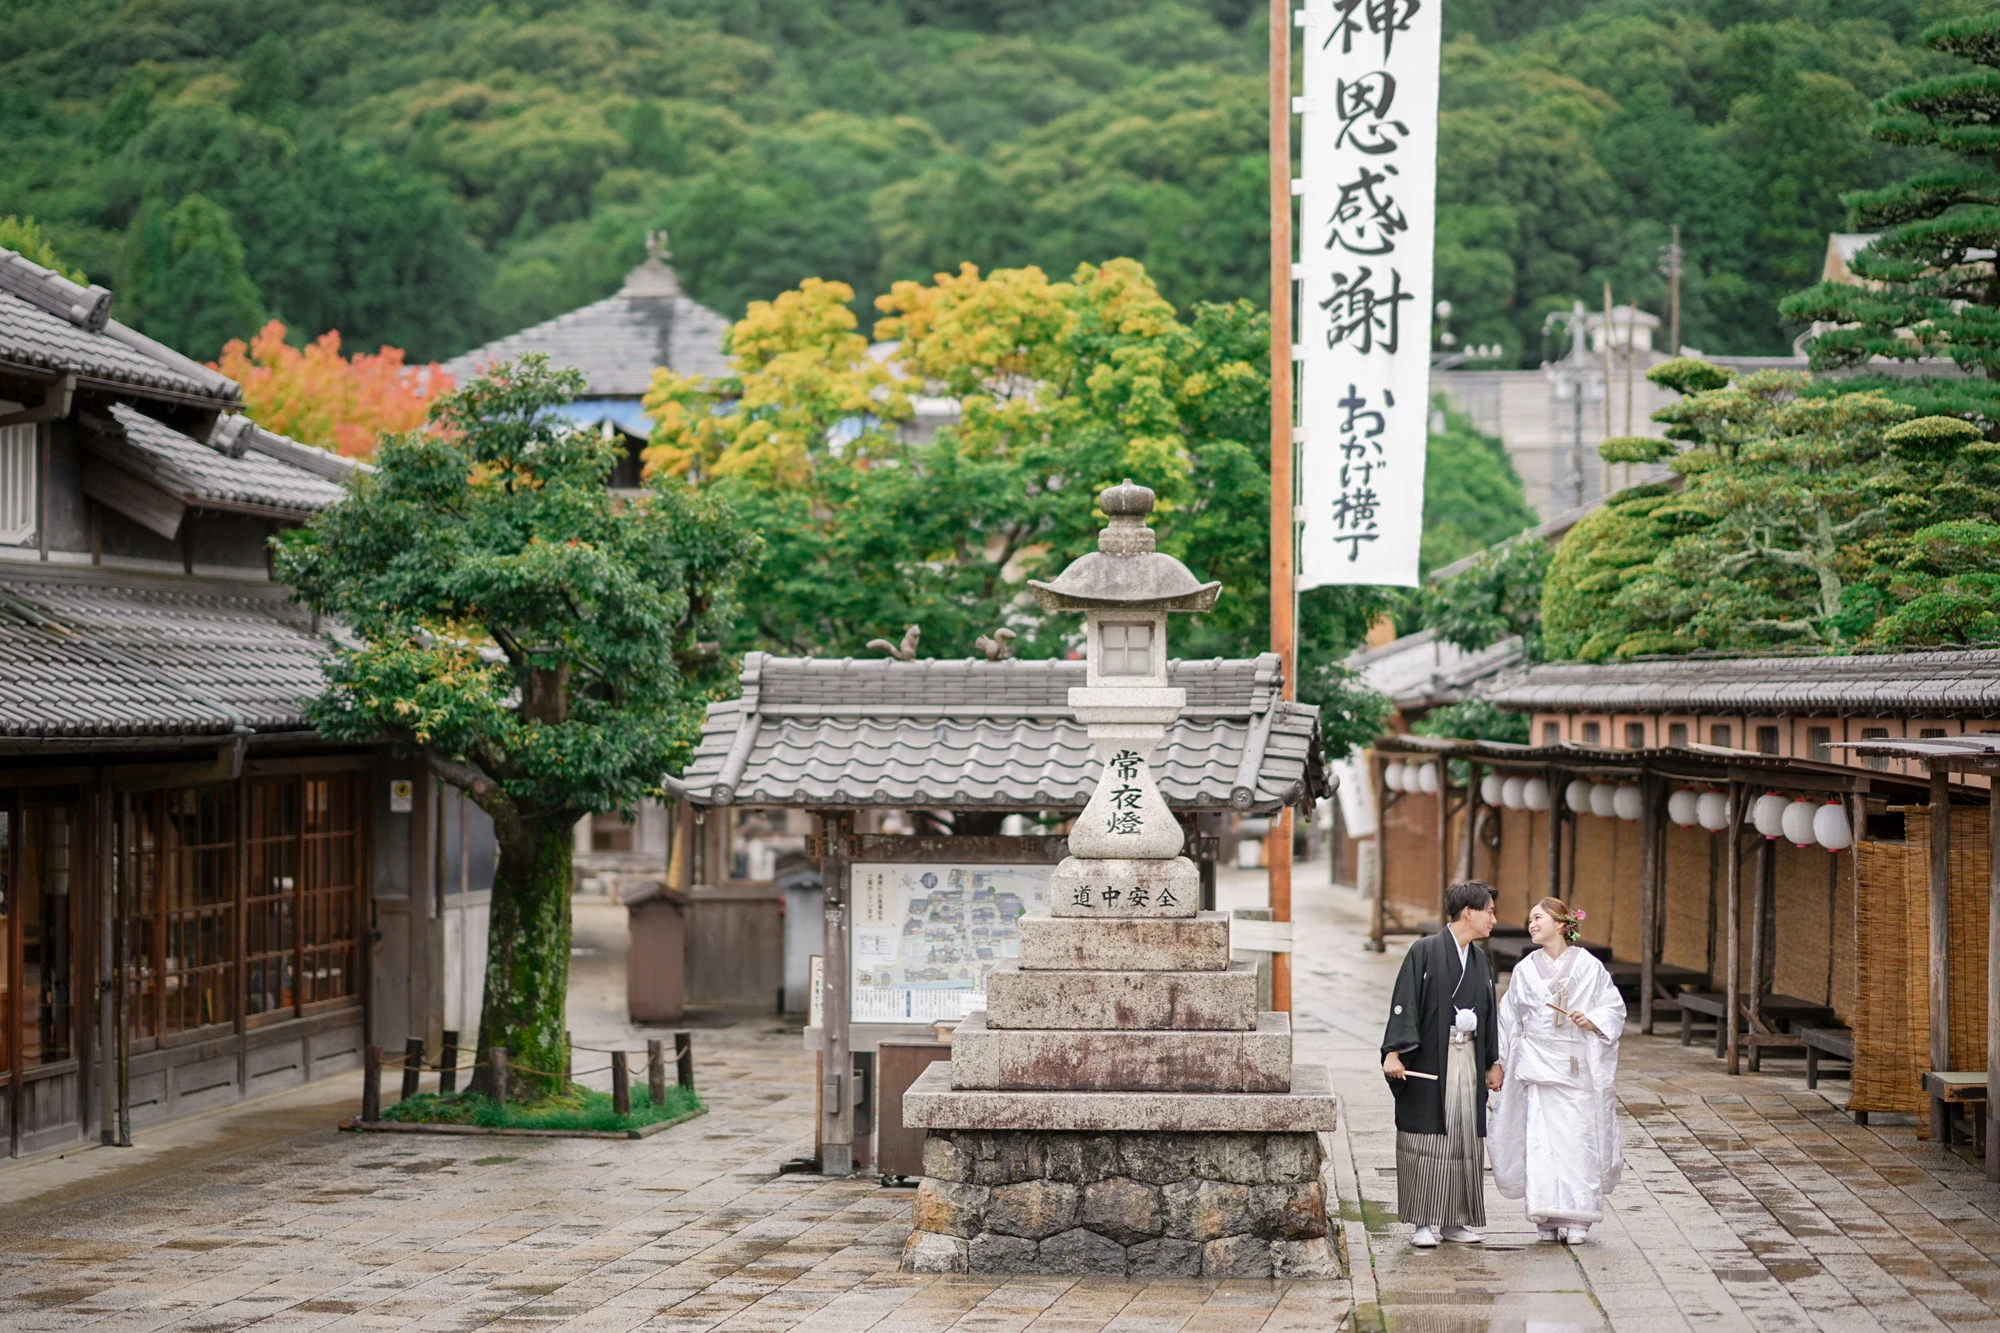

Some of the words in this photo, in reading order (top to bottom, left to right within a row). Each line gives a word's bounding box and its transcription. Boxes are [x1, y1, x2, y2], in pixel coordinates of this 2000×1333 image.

[1319, 0, 1421, 355] 神恩感謝
[1332, 383, 1395, 562] おかげ横丁
[1105, 750, 1145, 835] 常夜燈
[1072, 885, 1178, 908] 道中安全
